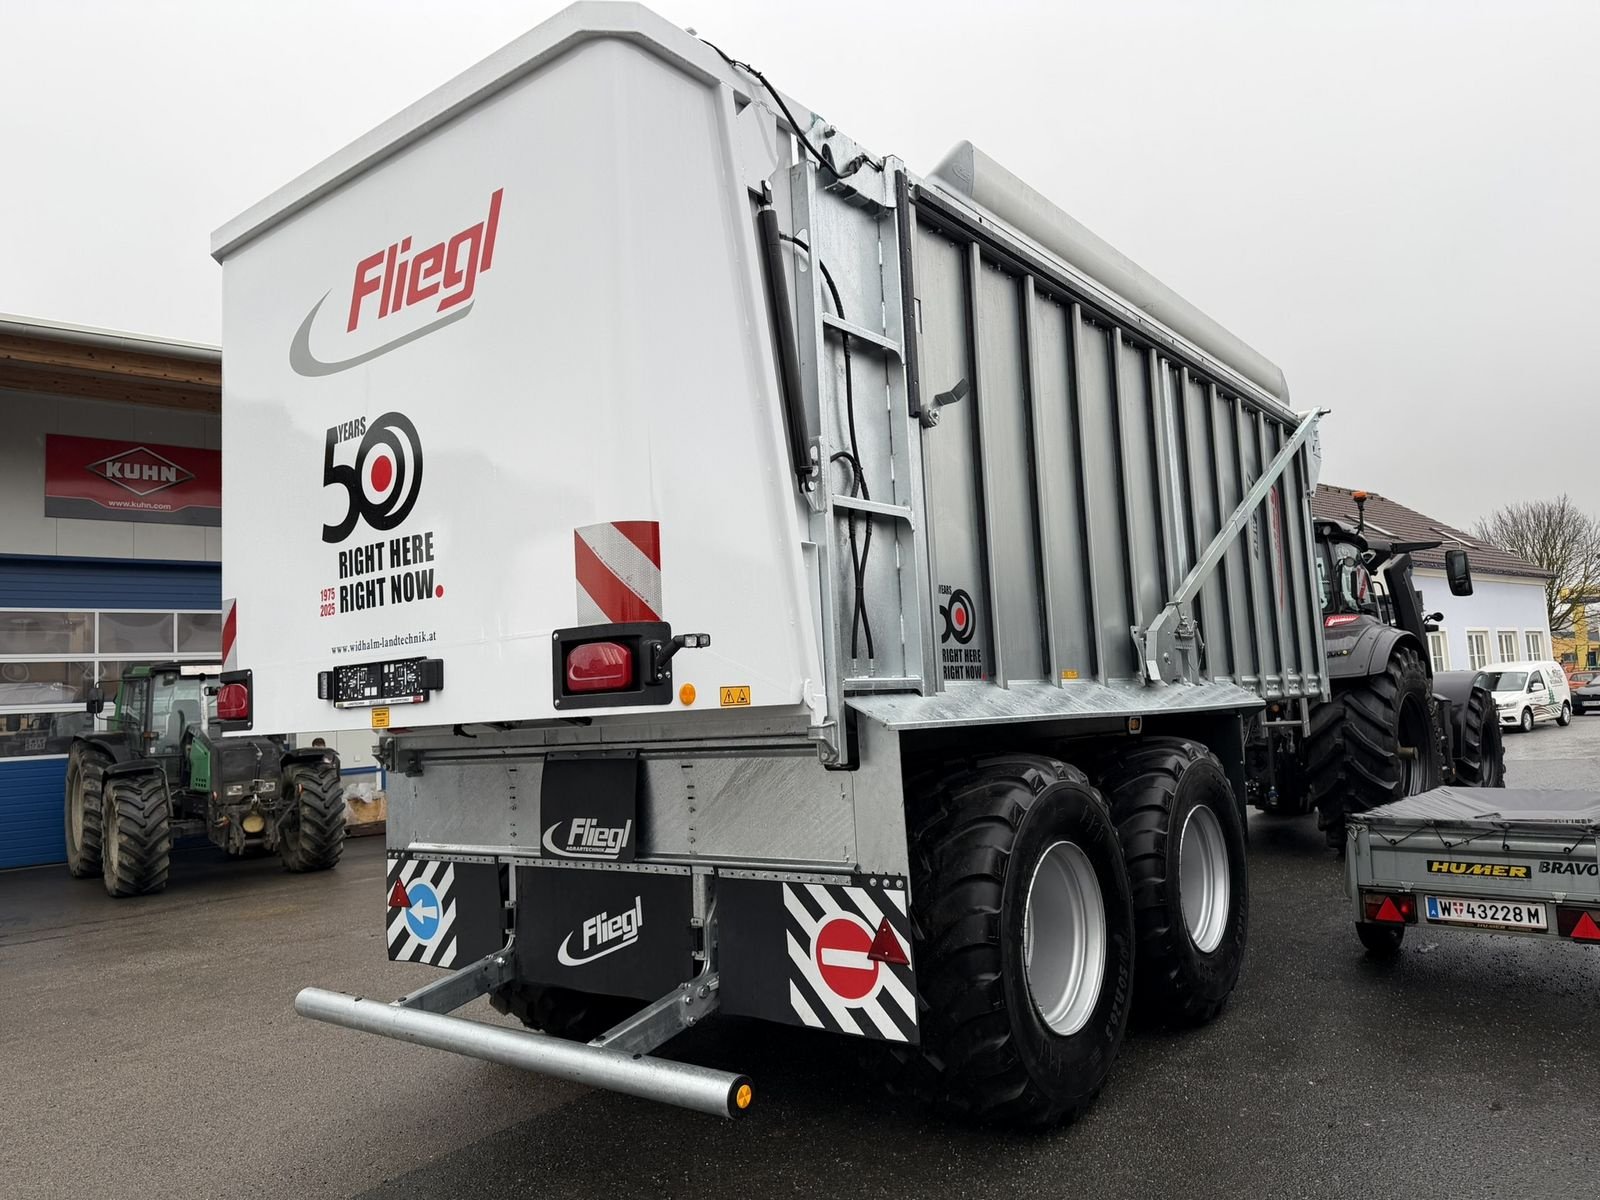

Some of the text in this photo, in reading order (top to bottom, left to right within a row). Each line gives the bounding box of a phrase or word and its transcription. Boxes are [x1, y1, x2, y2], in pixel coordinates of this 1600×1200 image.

[346, 187, 504, 333] Fliegl
[338, 416, 366, 443] YEARS
[106, 461, 177, 482] KUHN
[322, 411, 424, 544] 50
[108, 500, 172, 511] www.kuhn.com
[338, 531, 435, 580] RIGHT HERE
[320, 587, 336, 602] 1975
[339, 568, 444, 614] RIGHT NOW.
[319, 603, 336, 618] 2025
[331, 631, 437, 654] www.widhalm-landtechnik.at
[942, 648, 981, 663] RIGHT HERE
[943, 665, 964, 680] RIGHT
[567, 818, 632, 854] Fliegl
[1431, 861, 1528, 878] HUMER
[1538, 861, 1598, 876] BRAVO
[583, 895, 643, 952] Fliegl
[1439, 901, 1540, 924] W 43228 M
